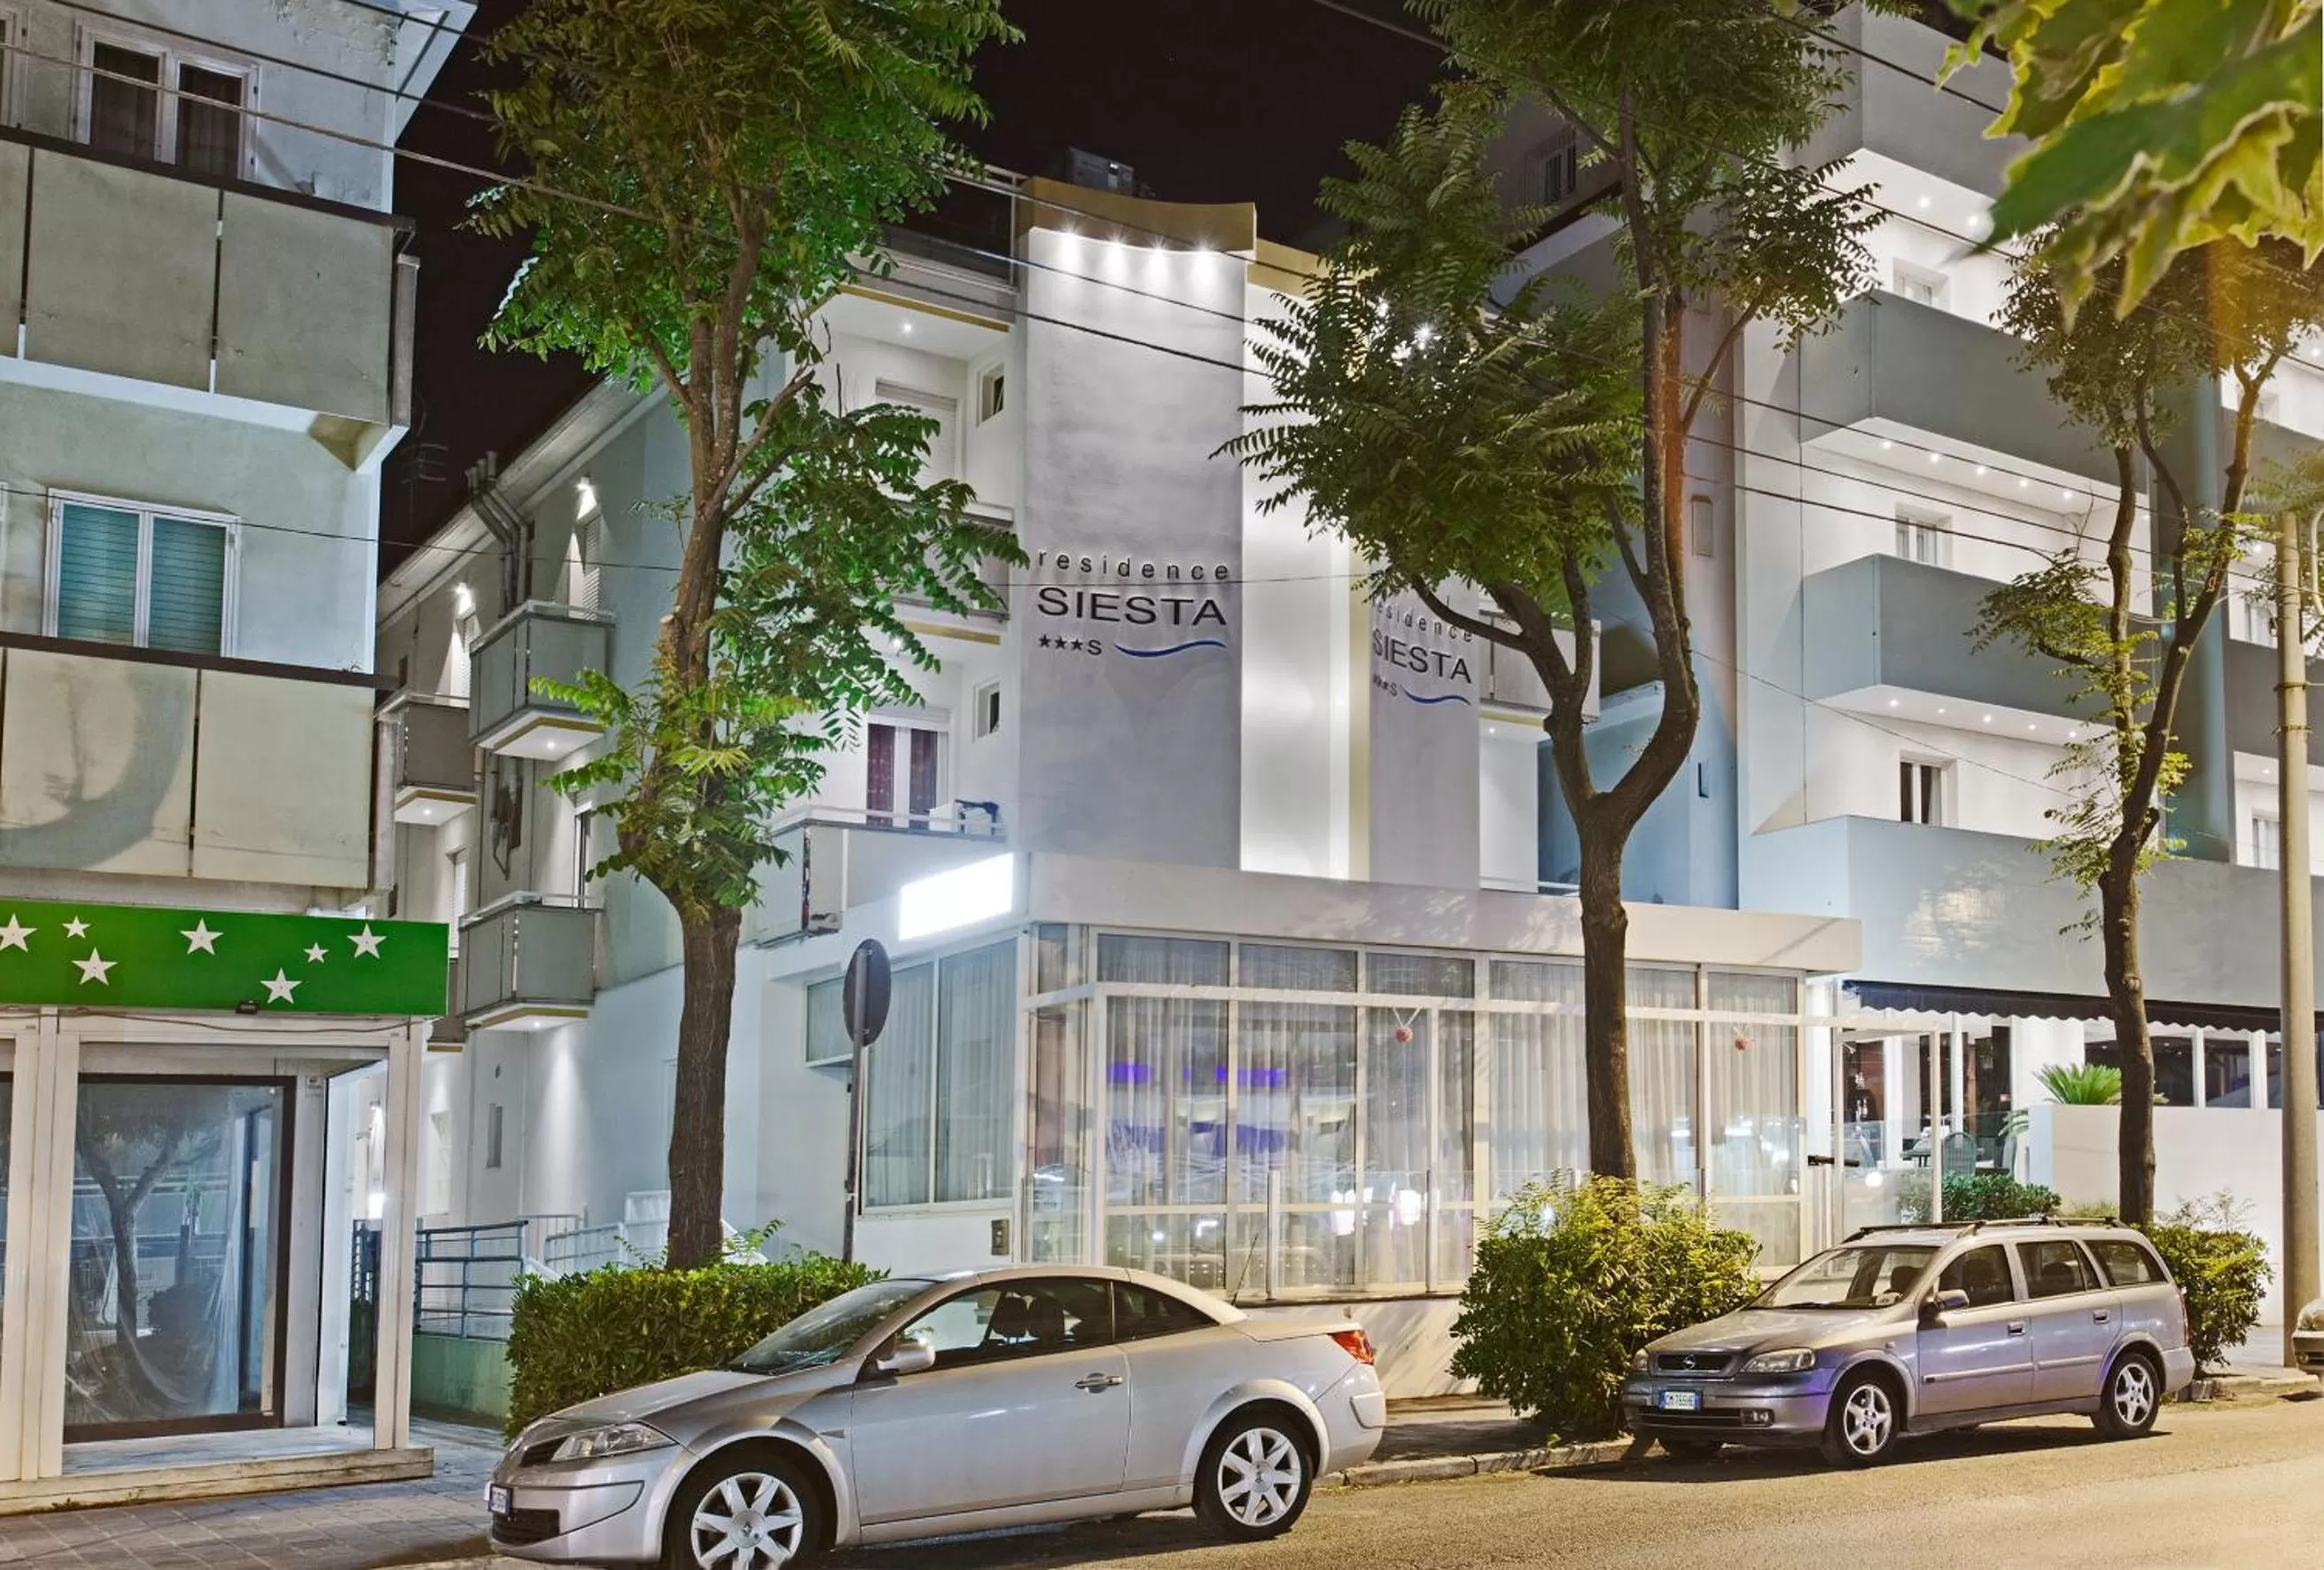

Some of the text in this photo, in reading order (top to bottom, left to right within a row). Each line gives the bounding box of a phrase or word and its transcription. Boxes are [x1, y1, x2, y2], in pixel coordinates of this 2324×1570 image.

[1038, 550, 1228, 581] residence
[1037, 587, 1228, 626] SIESTA
[1372, 627, 1472, 684] SIESTA
